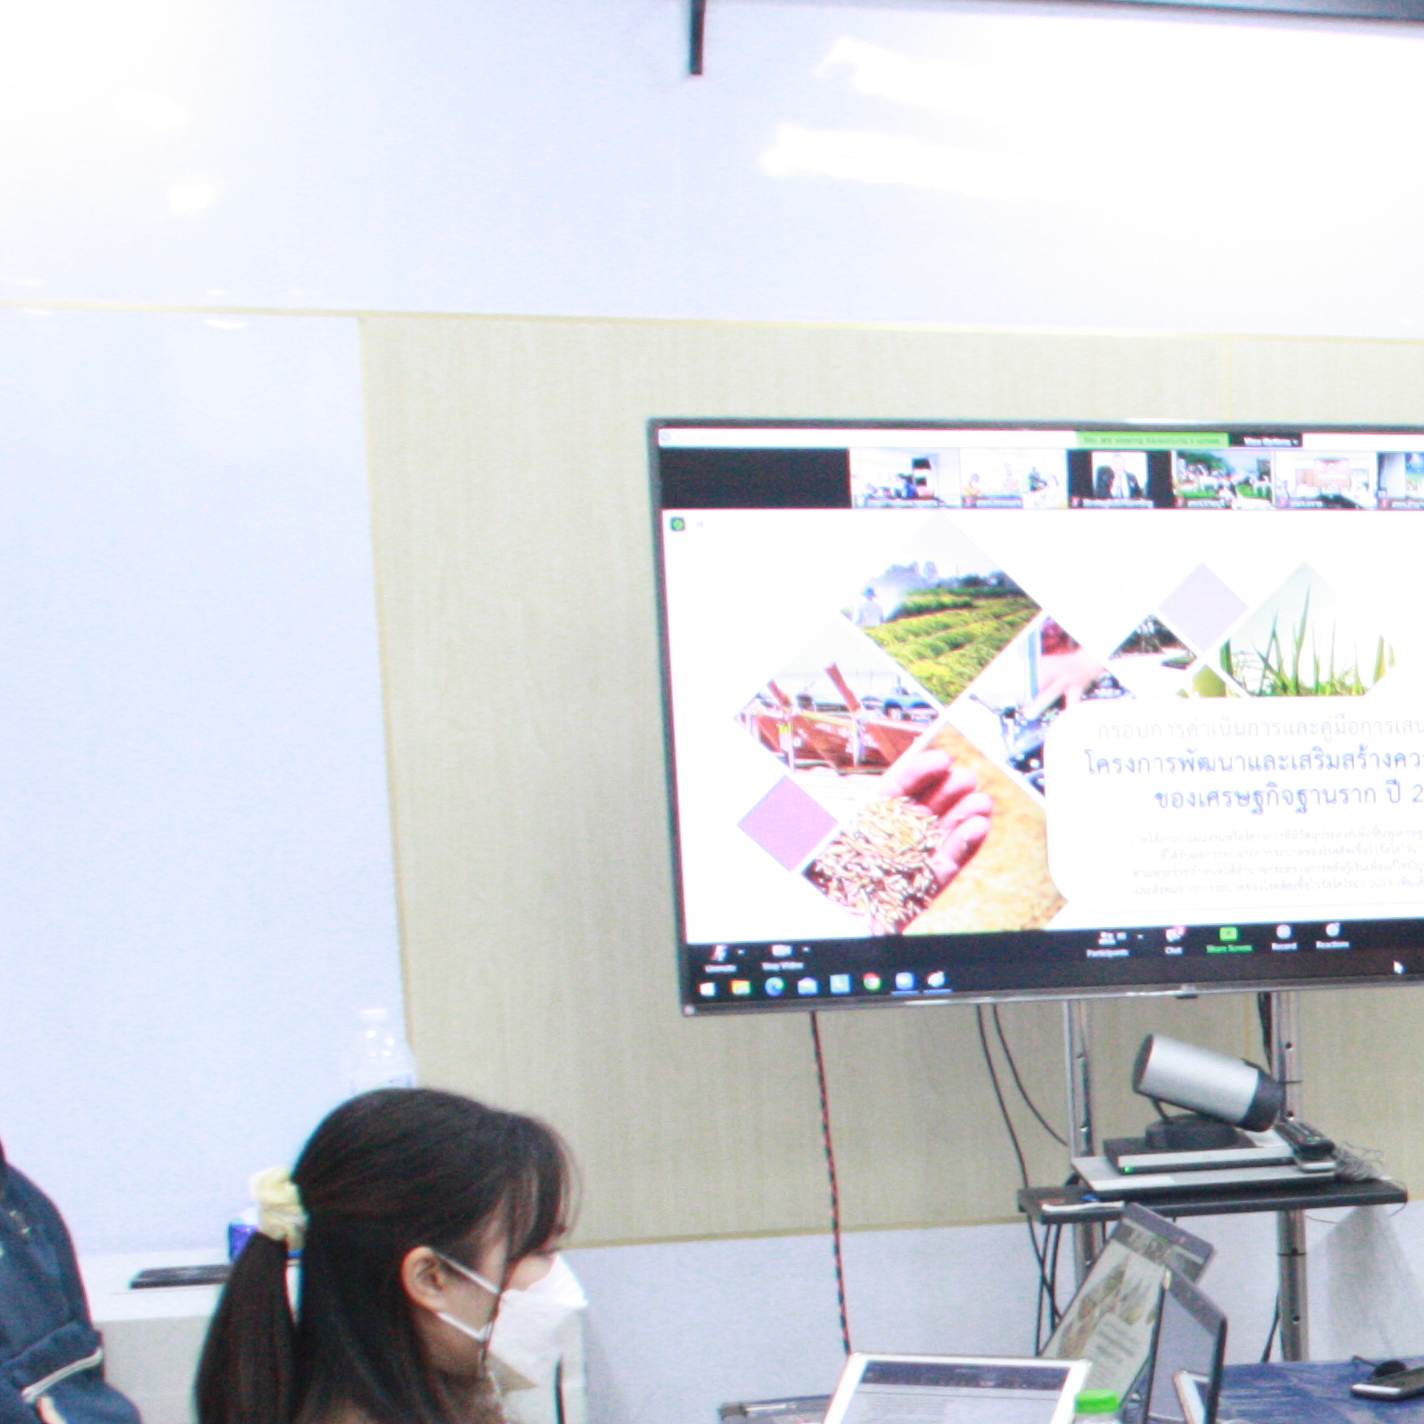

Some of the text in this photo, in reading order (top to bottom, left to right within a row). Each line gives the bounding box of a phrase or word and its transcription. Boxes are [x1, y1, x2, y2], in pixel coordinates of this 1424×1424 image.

[1155, 781, 1378, 816] ของเศรษฐกิจฐานราก
[1386, 777, 1402, 806] ปี
